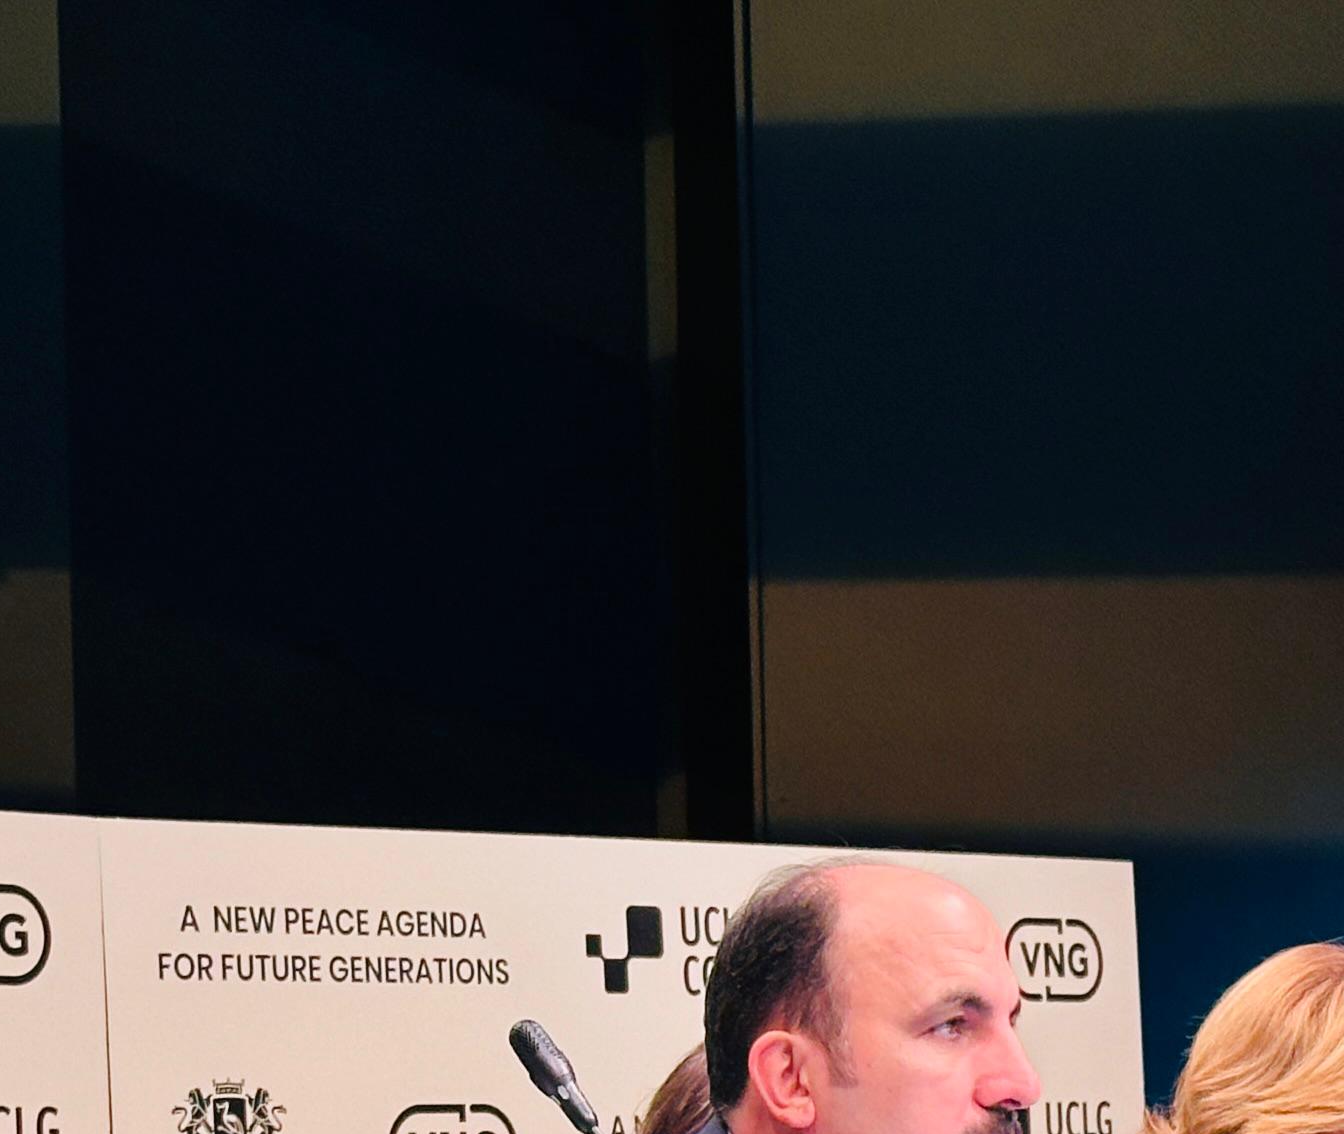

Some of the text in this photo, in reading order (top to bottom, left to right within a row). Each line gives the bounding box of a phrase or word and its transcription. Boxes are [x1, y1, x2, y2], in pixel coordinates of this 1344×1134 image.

[181, 905, 486, 938] A NEW PEACE AGENDA
[680, 906, 729, 946] UC
[159, 953, 509, 984] FOR FUTURE GENERATIONS
[1020, 942, 1088, 978] VNG
